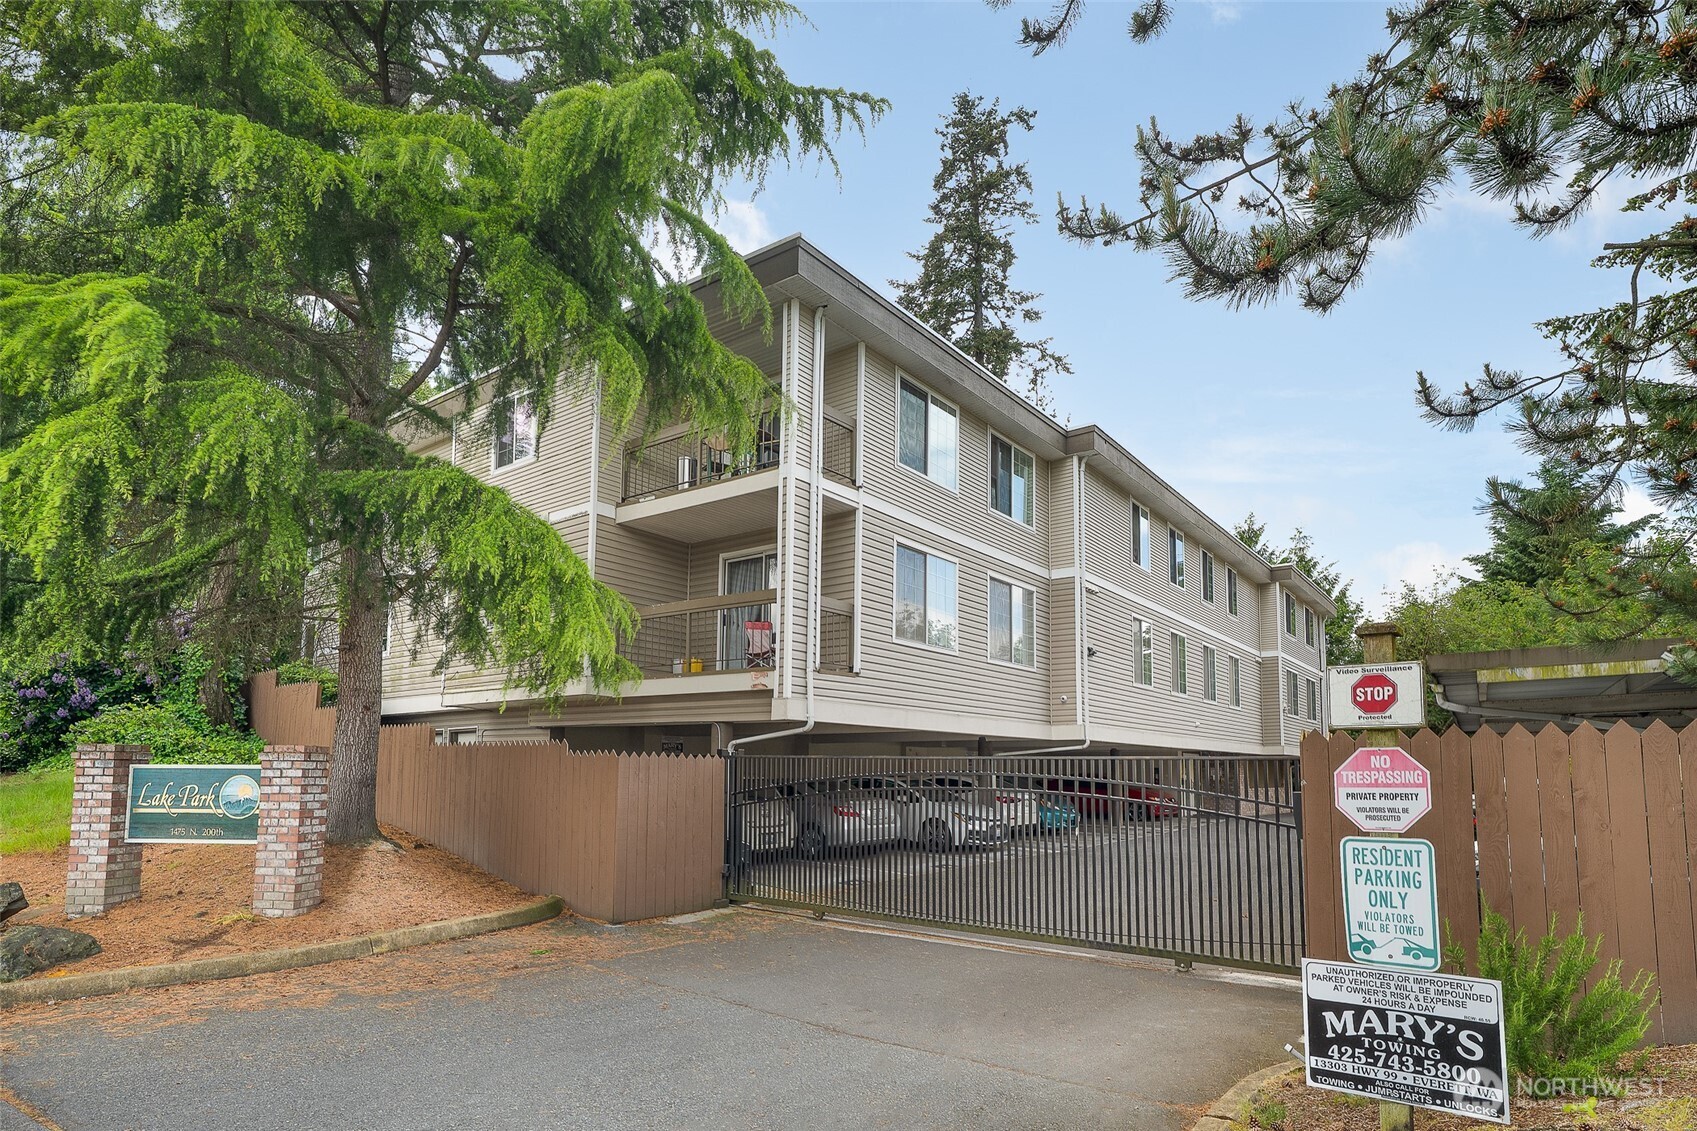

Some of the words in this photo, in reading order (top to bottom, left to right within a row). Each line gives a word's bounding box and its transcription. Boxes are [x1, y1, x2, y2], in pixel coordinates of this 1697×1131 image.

[1361, 665, 1413, 674] Surveillance
[1355, 686, 1394, 702] STOP
[1370, 755, 1391, 769] NO
[1340, 770, 1423, 784] TRESPASSING
[137, 781, 178, 817] Lake
[178, 782, 225, 817] Park
[1346, 792, 1377, 800] PRIVATE
[1379, 792, 1419, 801] PROPERTY
[1365, 814, 1401, 822] PROSECUTED
[170, 827, 186, 836] 1475
[202, 827, 224, 836] 200th
[1352, 847, 1422, 868] RESIDENT
[1354, 868, 1422, 889] PARKING
[1368, 890, 1408, 910] ONLY
[1364, 910, 1415, 924] VIOLATORS
[1357, 921, 1376, 932] WILL
[1380, 924, 1390, 934] BE
[1394, 925, 1424, 936] TOWED
[1311, 973, 1346, 984] PARKED
[1347, 977, 1391, 990] VEHICLES
[1393, 983, 1416, 993] WILL
[1418, 986, 1431, 995] BE
[1434, 989, 1493, 1003] IMPOUNDED
[1325, 967, 1395, 982] UNAUTHORIZED
[1396, 975, 1411, 984] OR
[1413, 977, 1474, 992] IMPROPERLY
[1333, 984, 1344, 992] AT
[1345, 985, 1387, 997] OWNER'S
[1390, 991, 1412, 1001] RISK
[1413, 994, 1420, 1002] &
[1423, 995, 1467, 1009] EXPENSE
[1362, 996, 1372, 1004] 24
[1374, 997, 1406, 1009] HOURS
[1408, 1003, 1415, 1011] A
[1417, 1004, 1436, 1013] DAY
[1322, 1009, 1484, 1061] MARY'S
[1361, 1037, 1441, 1060] TOWING
[1328, 1044, 1481, 1084] 425-743-5800
[1314, 1058, 1348, 1072] 13303
[1352, 1065, 1380, 1077] HWY
[1383, 1070, 1398, 1080] 99
[1476, 1087, 1499, 1100] WA
[1375, 1080, 1394, 1088] ALSO
[1395, 1083, 1413, 1092] CALL
[1414, 1087, 1430, 1095] FOR
[1316, 1075, 1355, 1089] TOWING
[1365, 1085, 1433, 1104] JUMPSTARTS
[1444, 1099, 1498, 1117] UNLOCKS
